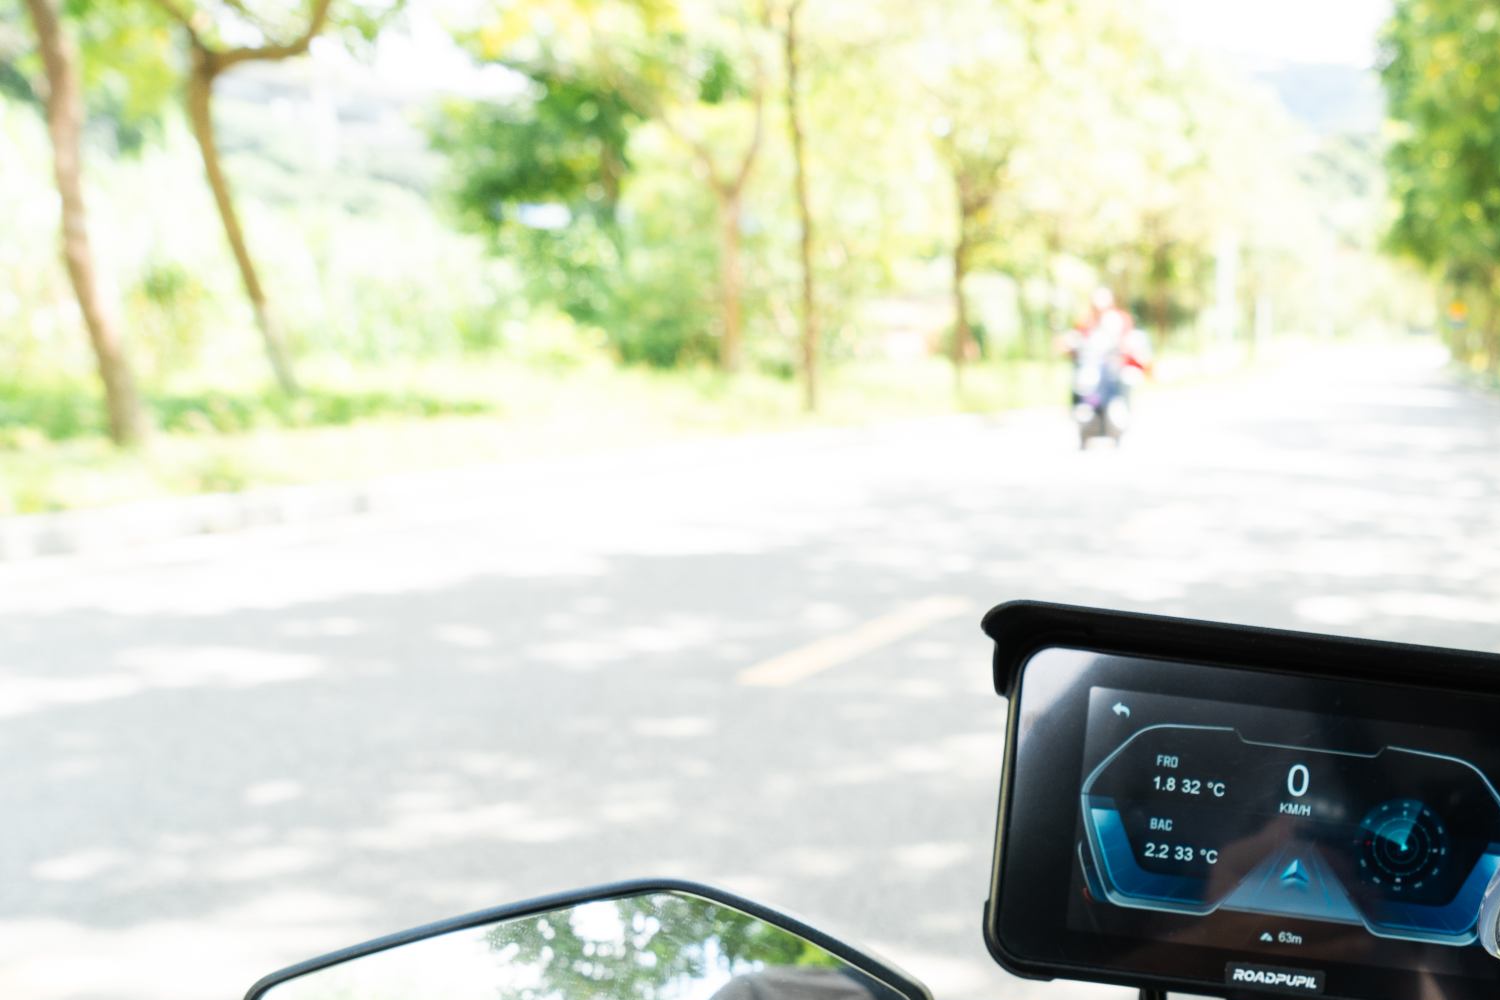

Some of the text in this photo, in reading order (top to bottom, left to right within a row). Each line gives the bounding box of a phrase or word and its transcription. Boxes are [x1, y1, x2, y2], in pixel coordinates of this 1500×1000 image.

[1153, 775, 1226, 798] 1.8 32 °C
[1287, 764, 1310, 797] 0
[1279, 802, 1311, 817] KM/H
[1149, 817, 1173, 832] BAC
[1144, 842, 1218, 865] 2.2 33 °C
[1278, 931, 1302, 945] 63m
[1232, 968, 1317, 990] ROADPUPIL
